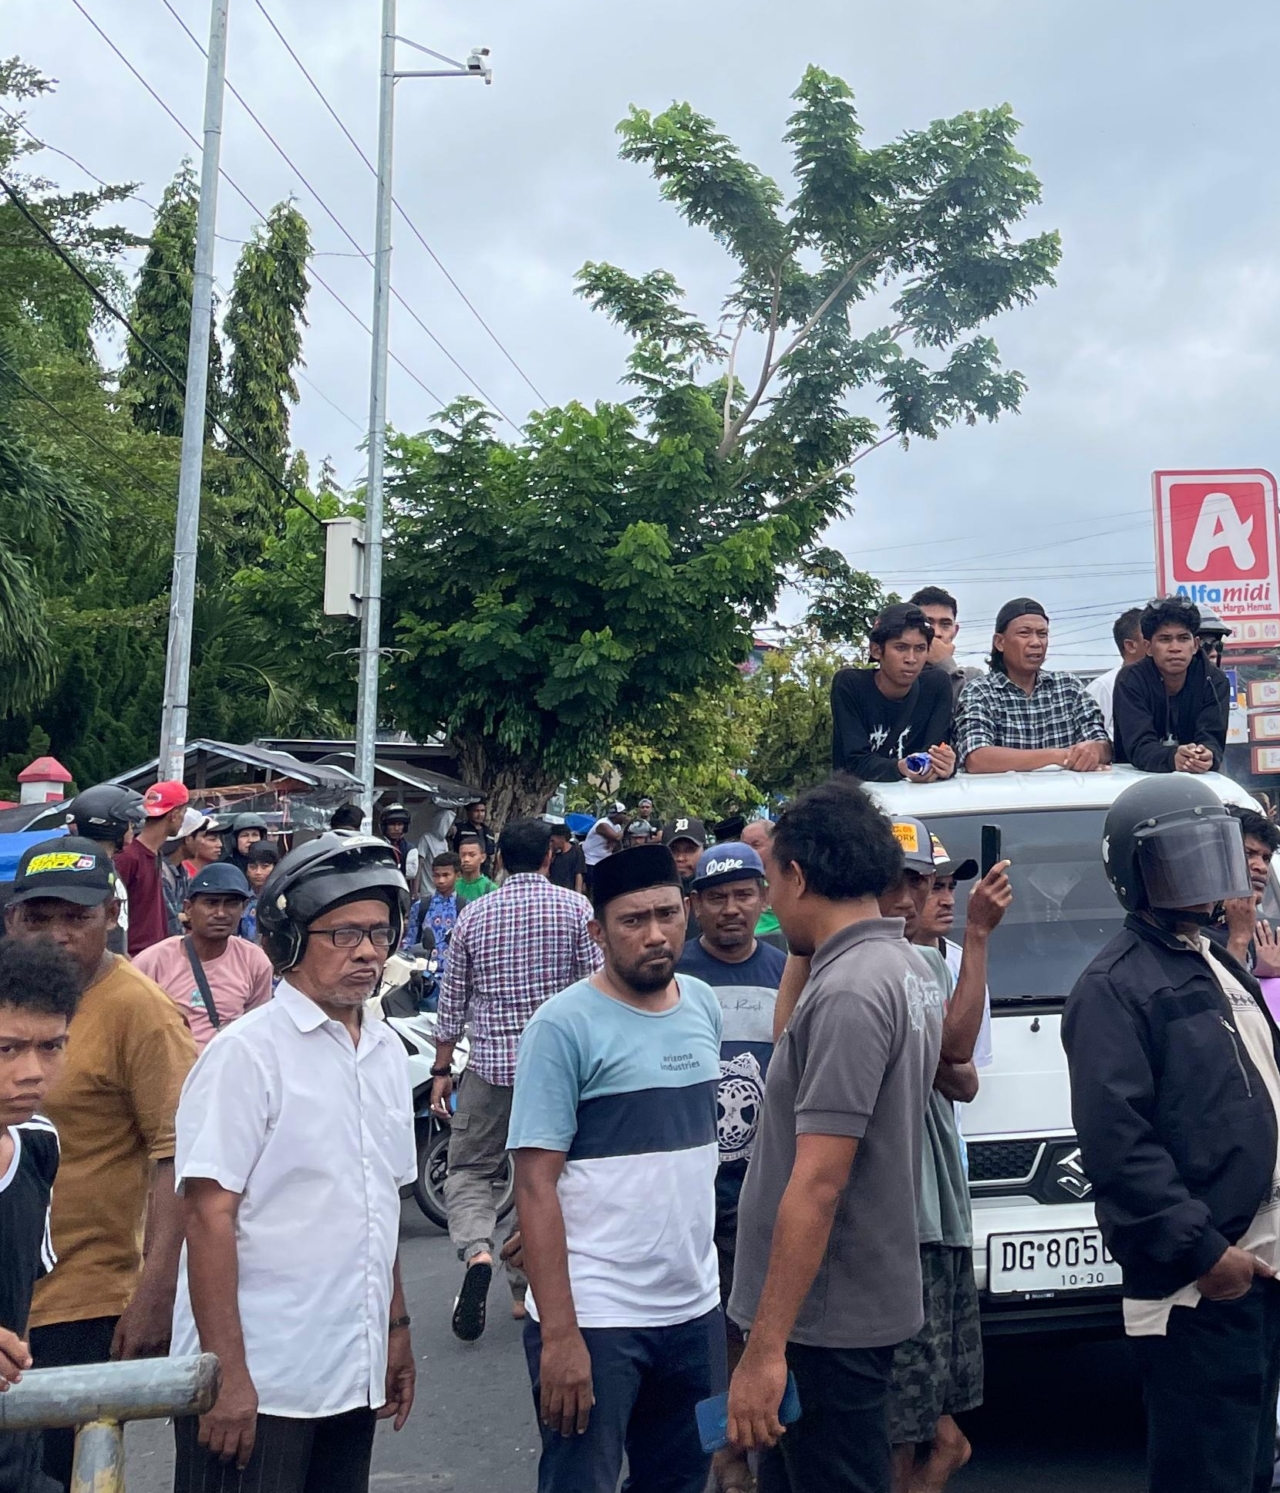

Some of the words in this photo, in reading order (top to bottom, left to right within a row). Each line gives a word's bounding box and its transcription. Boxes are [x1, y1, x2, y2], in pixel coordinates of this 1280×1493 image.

[1176, 582, 1270, 604] Alfamidi
[1223, 603, 1245, 614] Harga
[1247, 602, 1272, 612] Hemat
[897, 833, 916, 842] ORK
[706, 858, 743, 876] Dope
[663, 1053, 693, 1062] arizona
[660, 1060, 701, 1071] industries
[1002, 1241, 1035, 1272] DG
